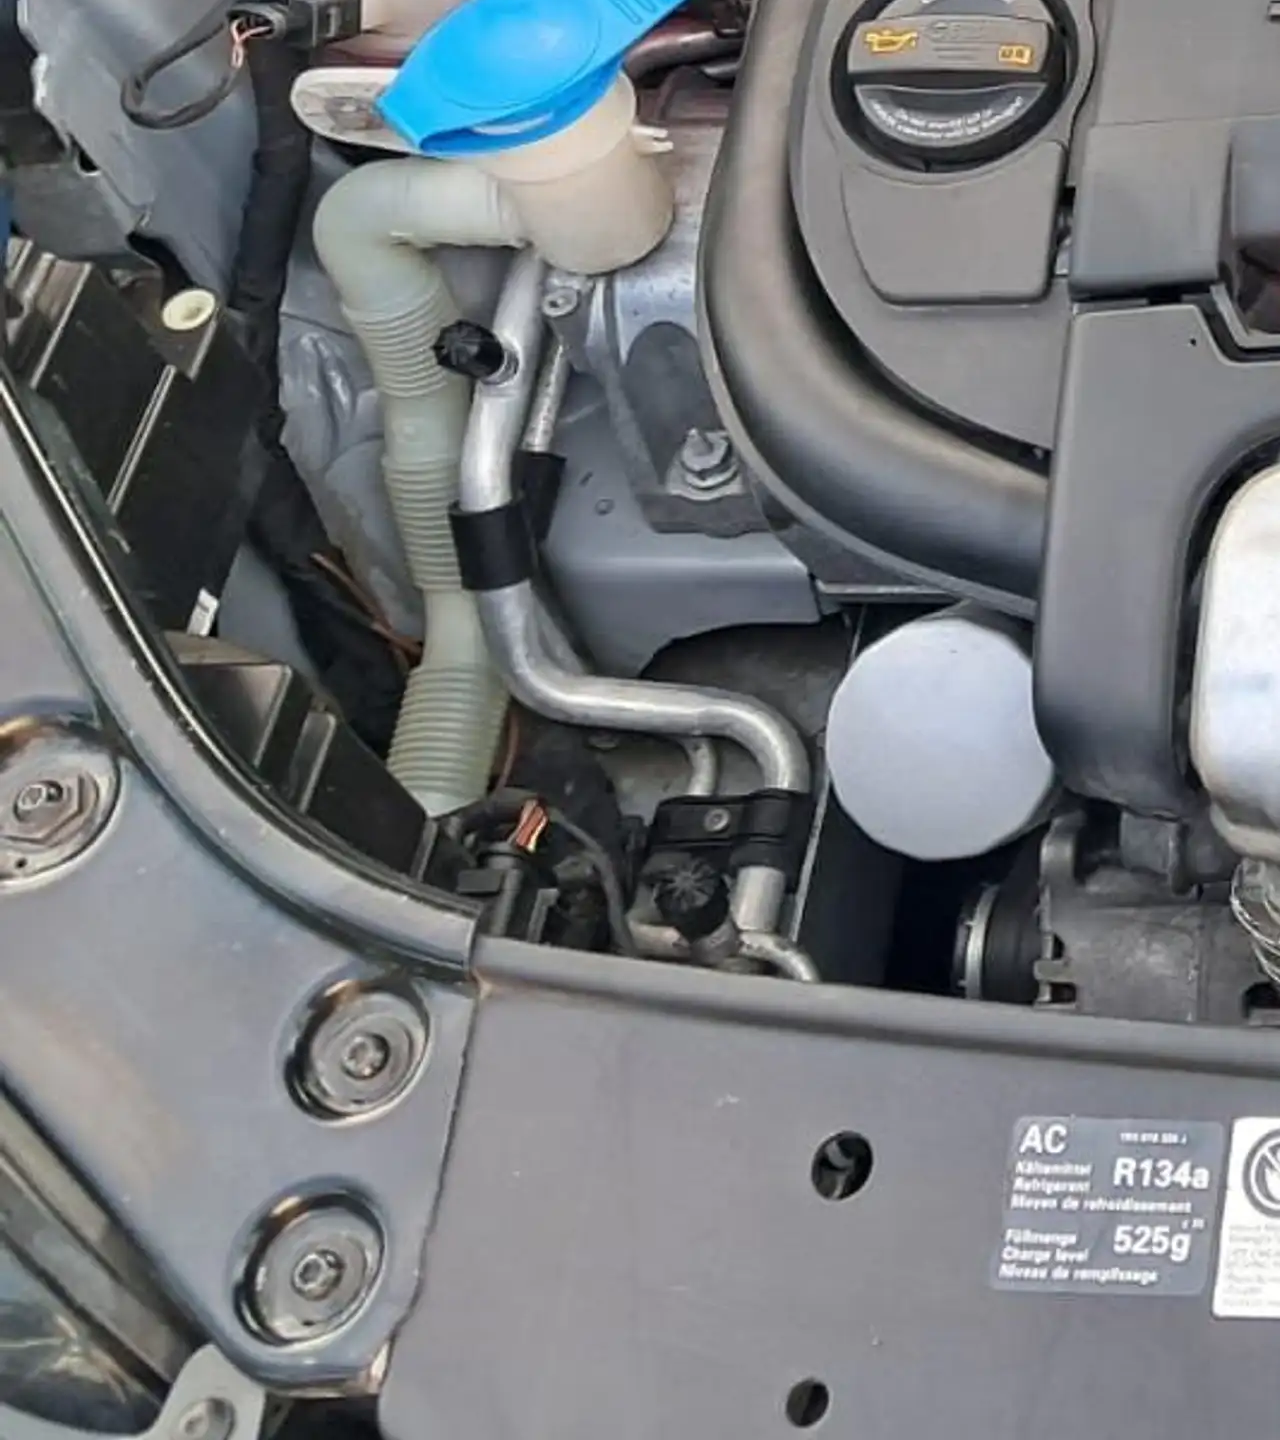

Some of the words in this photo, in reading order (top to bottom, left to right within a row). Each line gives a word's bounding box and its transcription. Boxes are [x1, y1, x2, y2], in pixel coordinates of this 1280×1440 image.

[1018, 1124, 1068, 1154] AC
[1112, 1157, 1210, 1189] R134a
[1113, 1224, 1192, 1262] 525g
